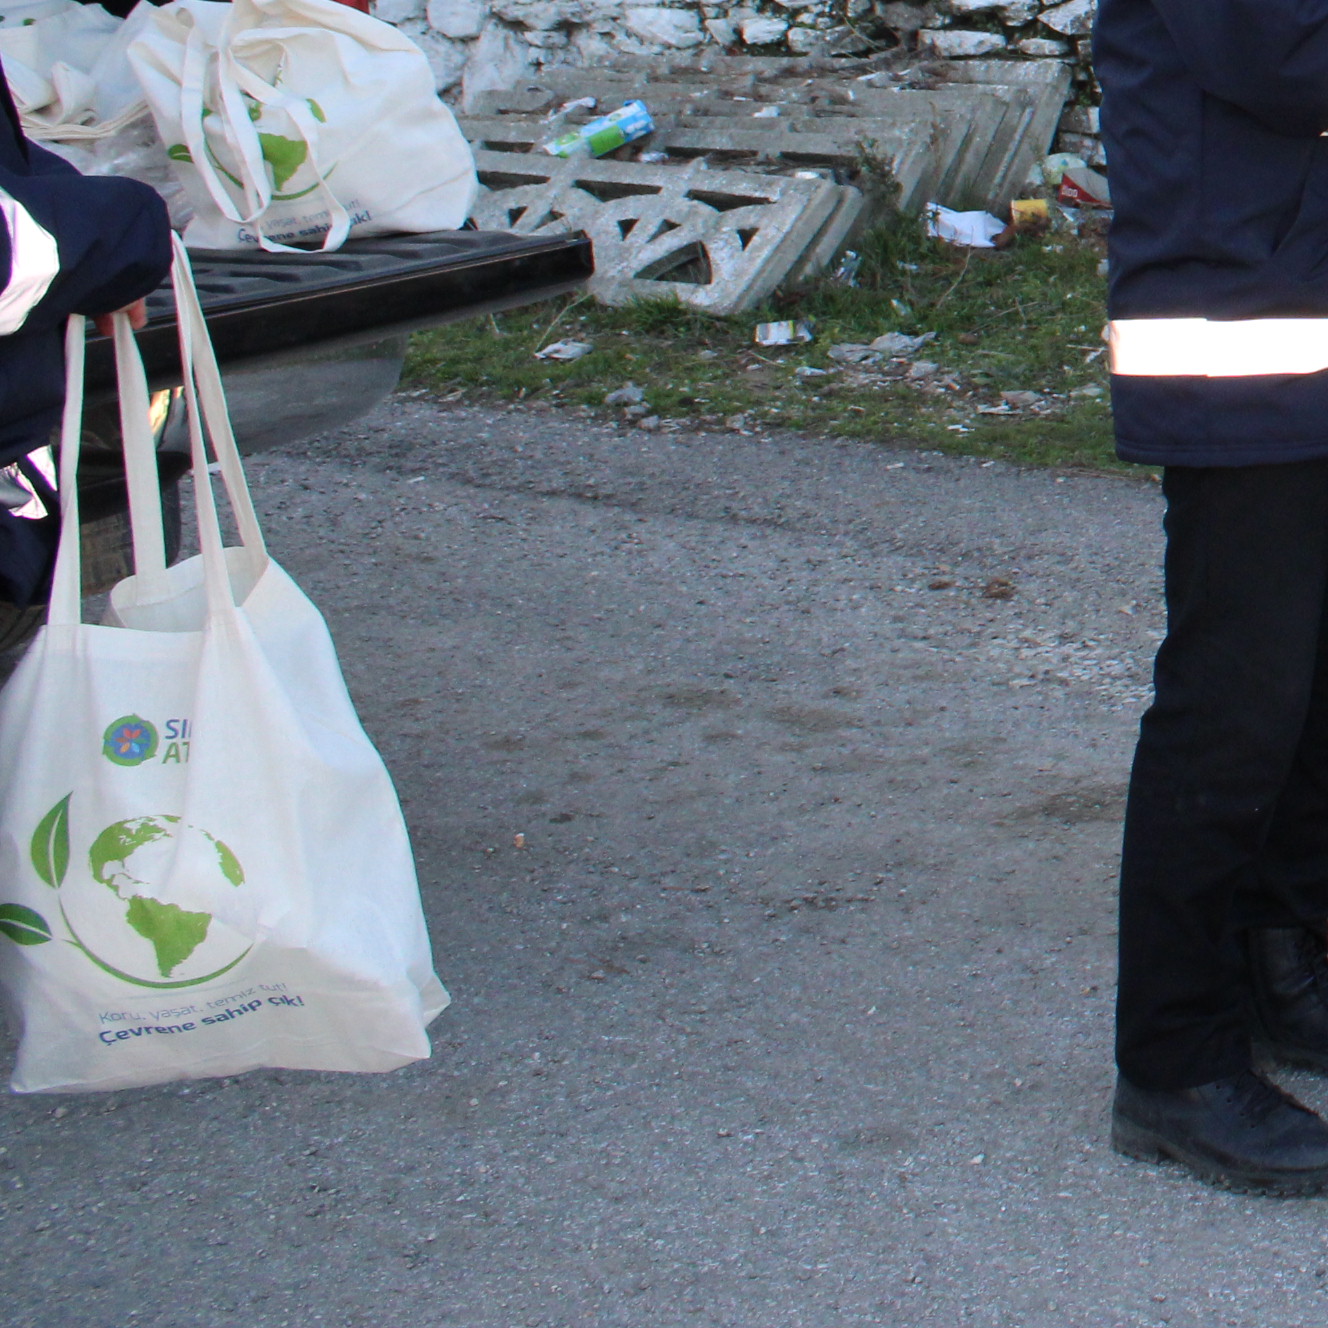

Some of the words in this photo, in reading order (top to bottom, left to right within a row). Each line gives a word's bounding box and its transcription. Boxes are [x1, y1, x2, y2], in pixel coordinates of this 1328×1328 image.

[299, 223, 332, 236] sahi
[206, 987, 256, 1010] temiz
[99, 1021, 197, 1046] Çevrene
[201, 998, 263, 1026] sahip
